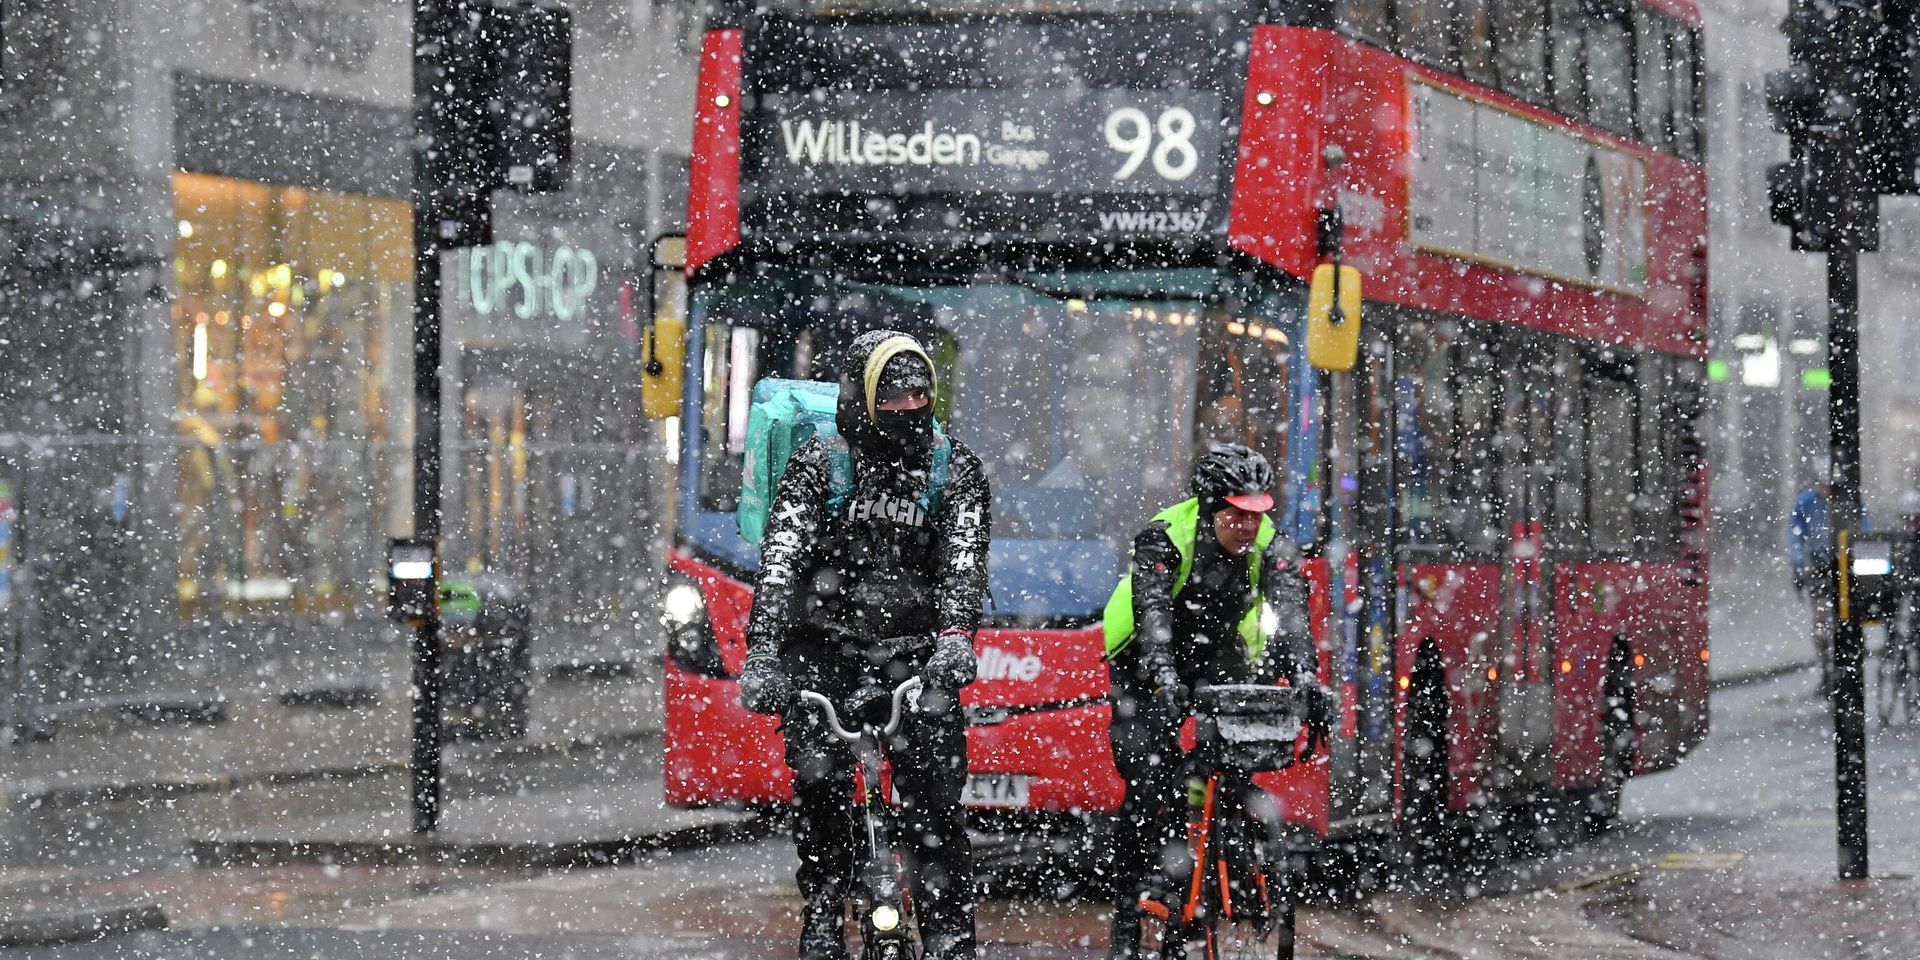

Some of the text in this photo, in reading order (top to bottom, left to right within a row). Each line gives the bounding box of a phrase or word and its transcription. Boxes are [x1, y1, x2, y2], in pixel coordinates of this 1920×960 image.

[781, 119, 981, 165] Willesden
[1001, 120, 1035, 142] Bus
[1104, 107, 1199, 181] 98
[986, 144, 1050, 171] Garage
[1099, 211, 1208, 232] VWH2367
